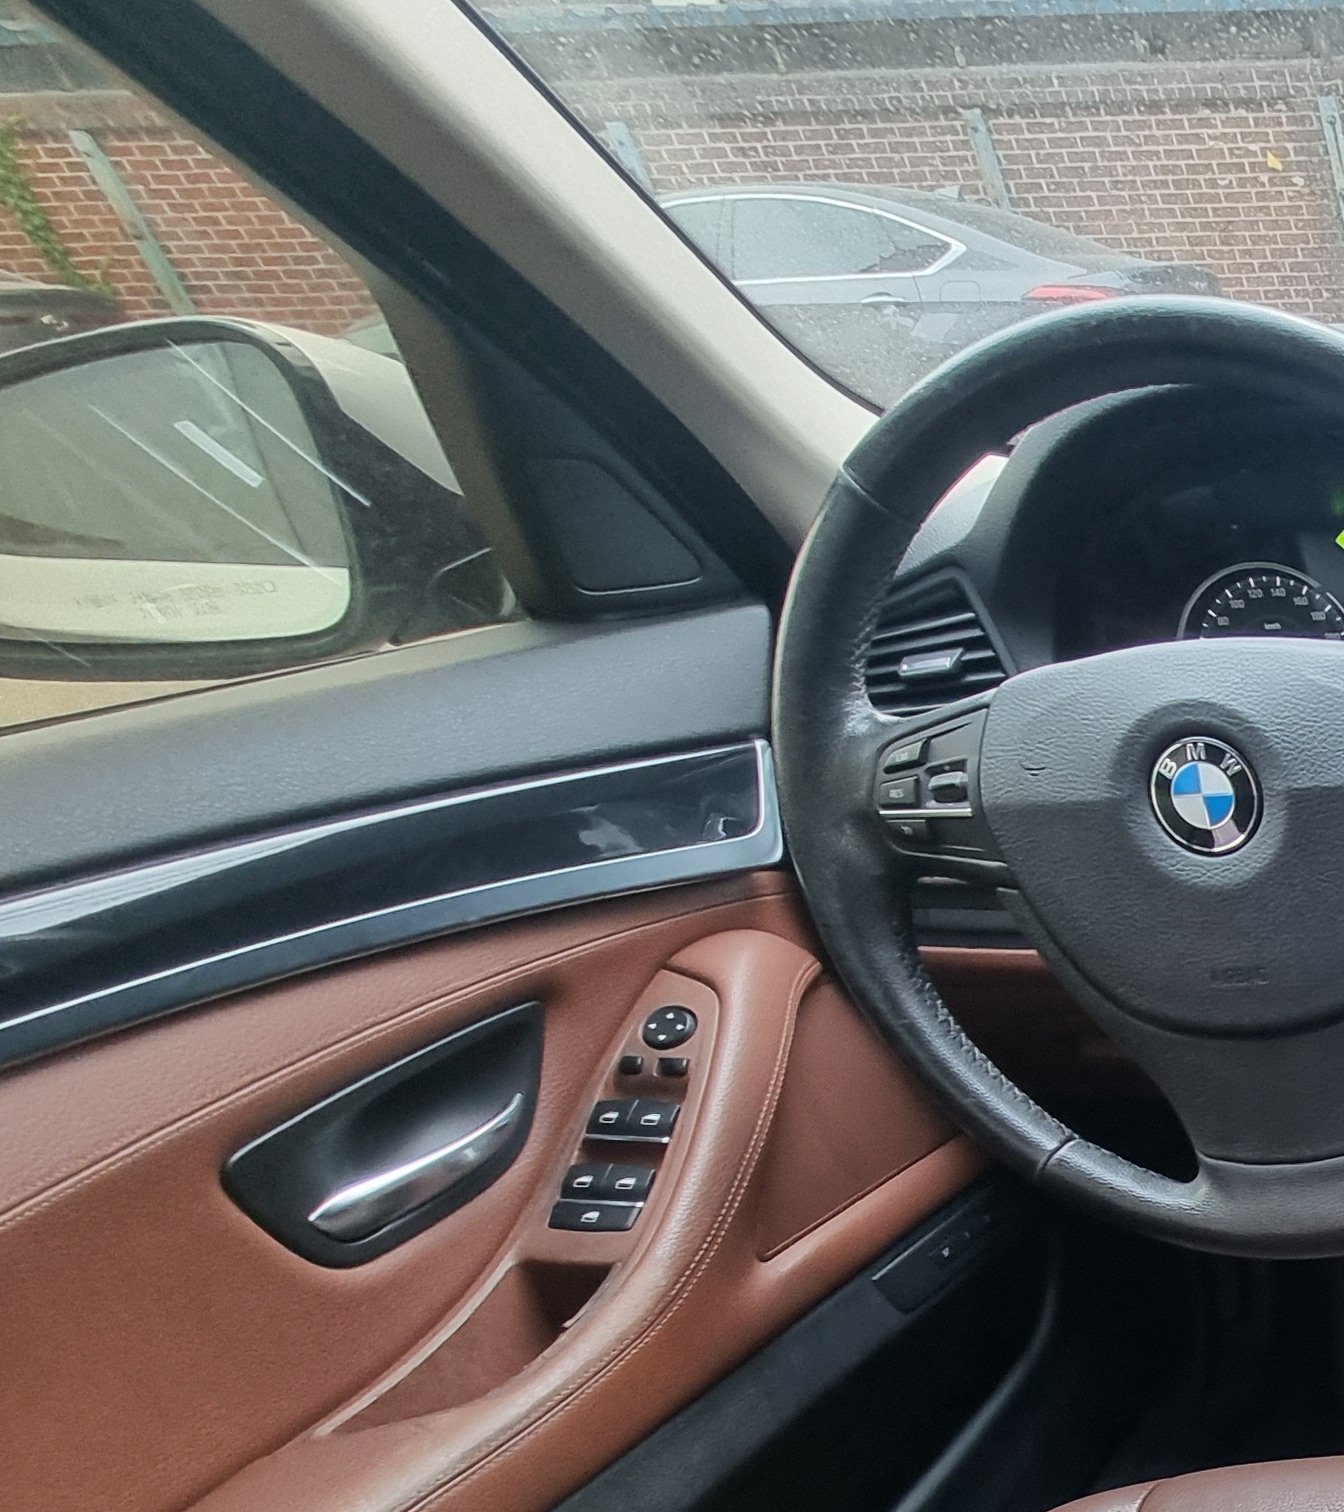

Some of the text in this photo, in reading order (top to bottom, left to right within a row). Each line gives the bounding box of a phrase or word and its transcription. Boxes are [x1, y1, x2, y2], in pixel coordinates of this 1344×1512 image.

[1248, 588, 1262, 598] 120
[1271, 588, 1286, 597] 140
[1159, 743, 1242, 779] BMW
